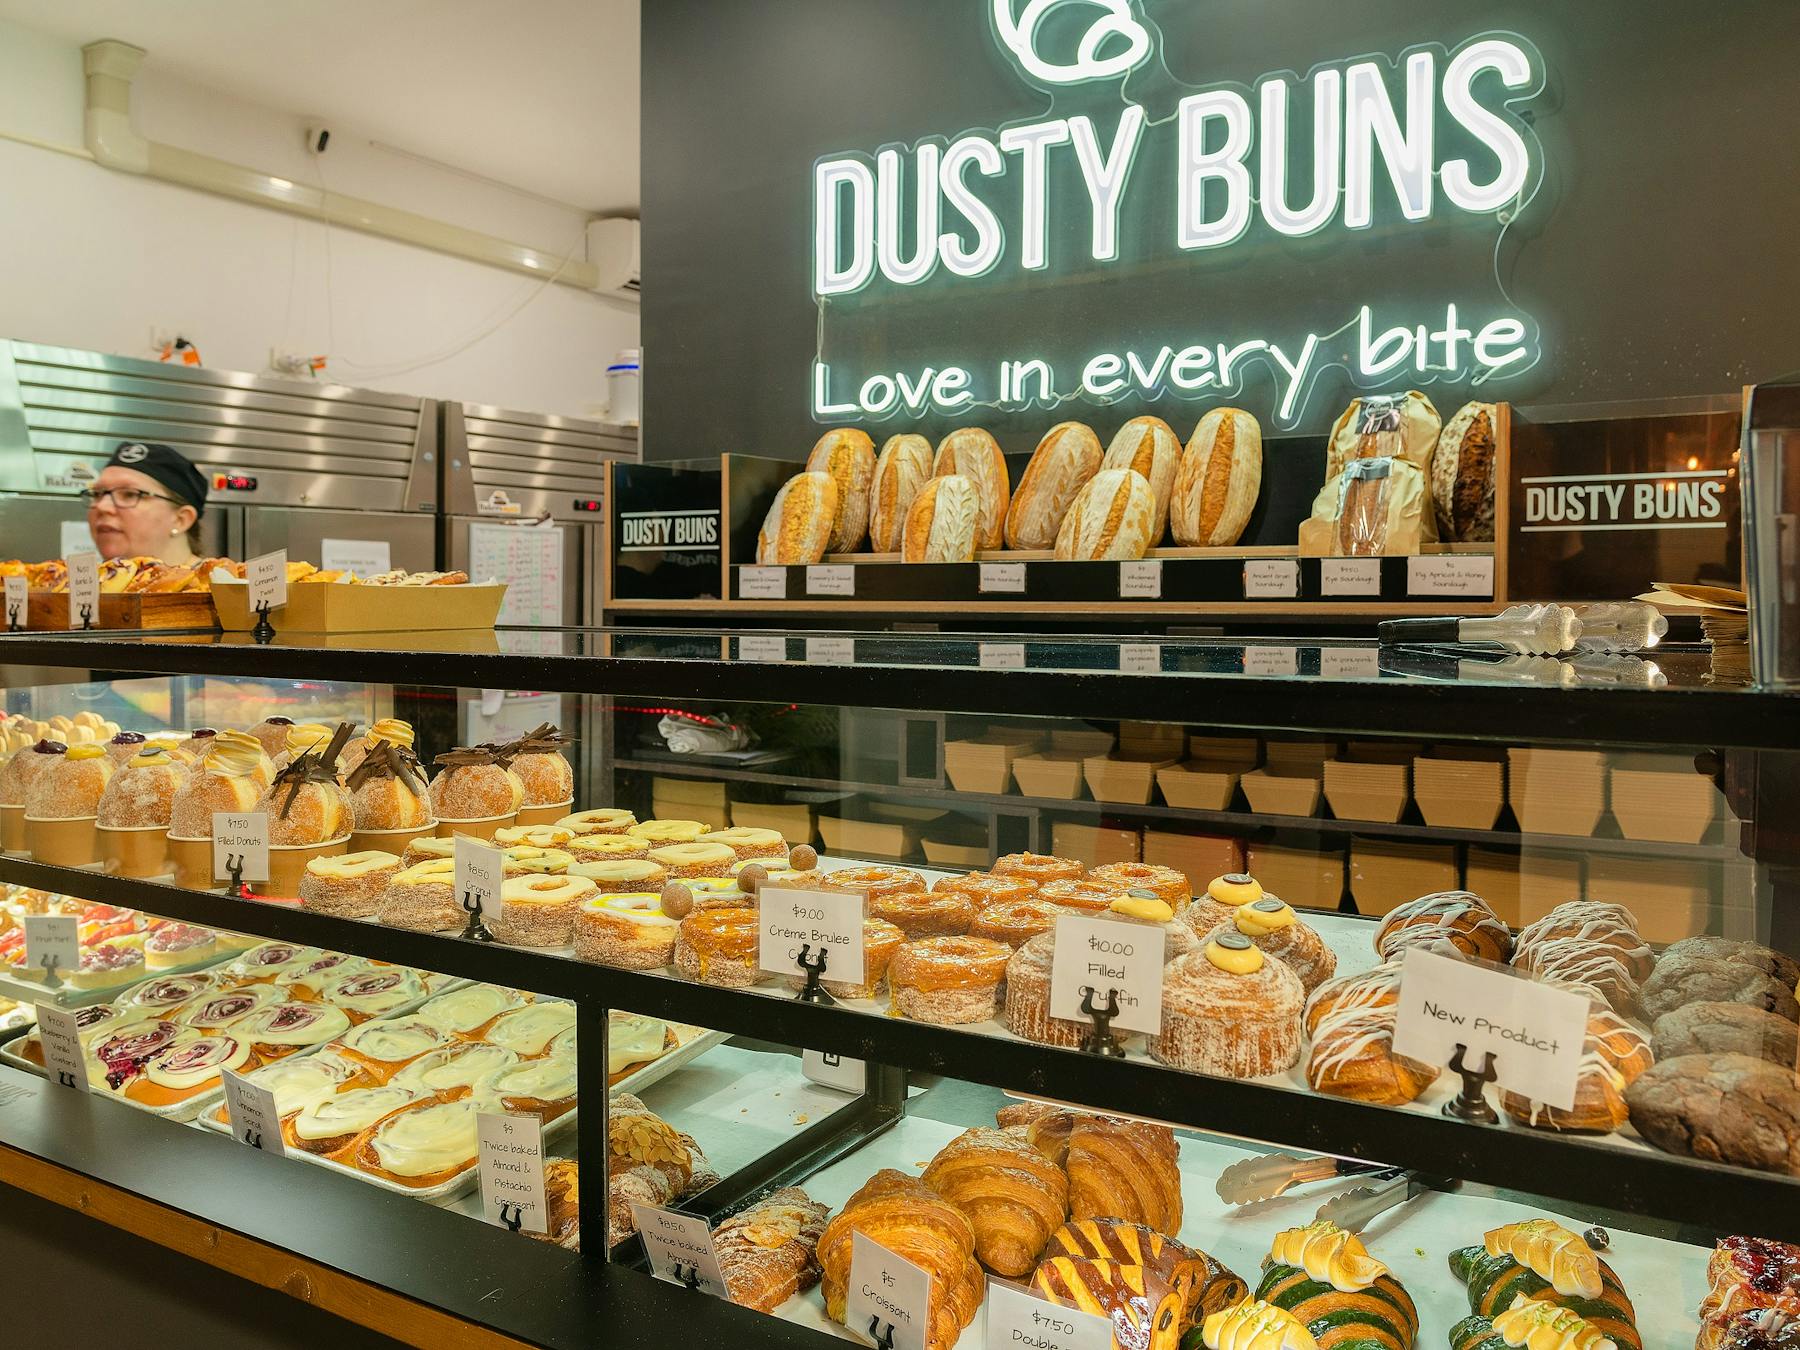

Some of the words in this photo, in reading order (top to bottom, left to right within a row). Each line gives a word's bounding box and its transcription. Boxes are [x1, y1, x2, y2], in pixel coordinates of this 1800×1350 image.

[814, 104, 1145, 296] DUSTY
[1177, 39, 1532, 249] BUNS
[814, 362, 971, 415] Love
[1001, 359, 1052, 402] in
[1082, 333, 1318, 420] every
[1359, 304, 1526, 375] bite
[1526, 484, 1626, 522] DUSTY
[1634, 481, 1721, 519] BUNS
[623, 519, 672, 545] DUSTY
[675, 517, 717, 543] BUNS
[1340, 576, 1375, 585] Sourdough
[1432, 581, 1469, 590] Sourdough
[217, 835, 235, 846] Filled
[236, 836, 261, 846] Donuts
[465, 880, 491, 899] Cronut
[792, 903, 824, 920] $9.00
[811, 929, 850, 945] Brulee
[1088, 934, 1134, 956] $10.00
[1088, 963, 1126, 980] Filled
[1423, 1001, 1466, 1026] New
[1473, 1017, 1560, 1055] Product
[51, 1053, 77, 1068] Custard
[503, 1122, 514, 1134] $9
[483, 1140, 508, 1153] Twice
[511, 1142, 538, 1156] baked
[492, 1159, 521, 1172] Almond
[494, 1178, 532, 1192] Pistachio
[647, 1230, 676, 1246] Twice
[677, 1239, 709, 1256] baked
[667, 1250, 699, 1268] Almond
[881, 1267, 896, 1288] $5
[862, 1284, 911, 1324] Croissant
[1032, 1309, 1074, 1335] $7.50
[1012, 1329, 1059, 1350] Double
